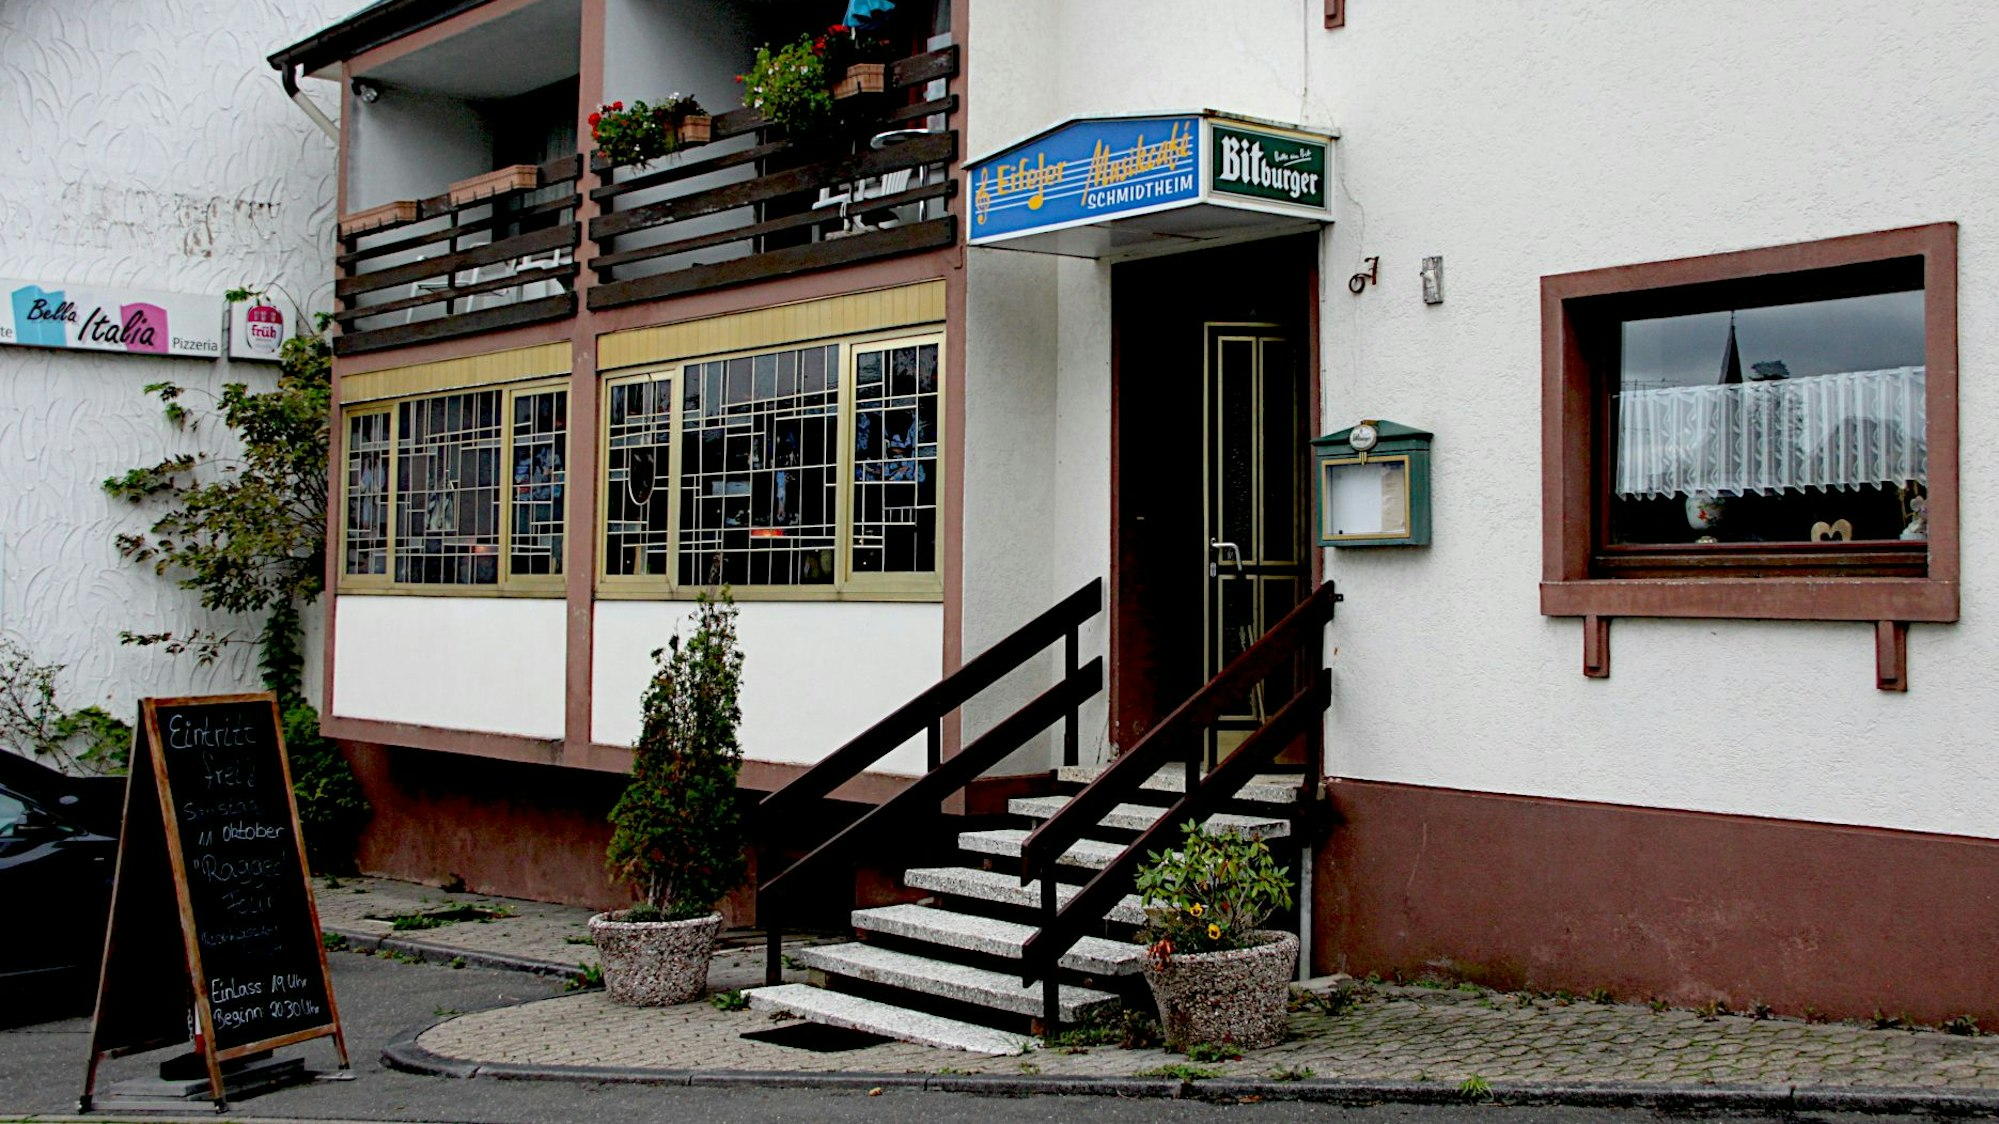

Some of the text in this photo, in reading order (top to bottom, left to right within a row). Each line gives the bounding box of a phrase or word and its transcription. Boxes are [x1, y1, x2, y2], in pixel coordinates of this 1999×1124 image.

[997, 153, 1067, 210] Eifeler
[1219, 135, 1319, 199] Bitburger
[1087, 174, 1193, 209] SCHMIDTHEIM
[27, 299, 155, 346] Bella Italia
[251, 324, 277, 339] früh
[173, 337, 218, 352] Pizzeria
[169, 713, 257, 749] Eintritt
[287, 973, 308, 989] Uhr
[300, 999, 320, 1015] Uhr
